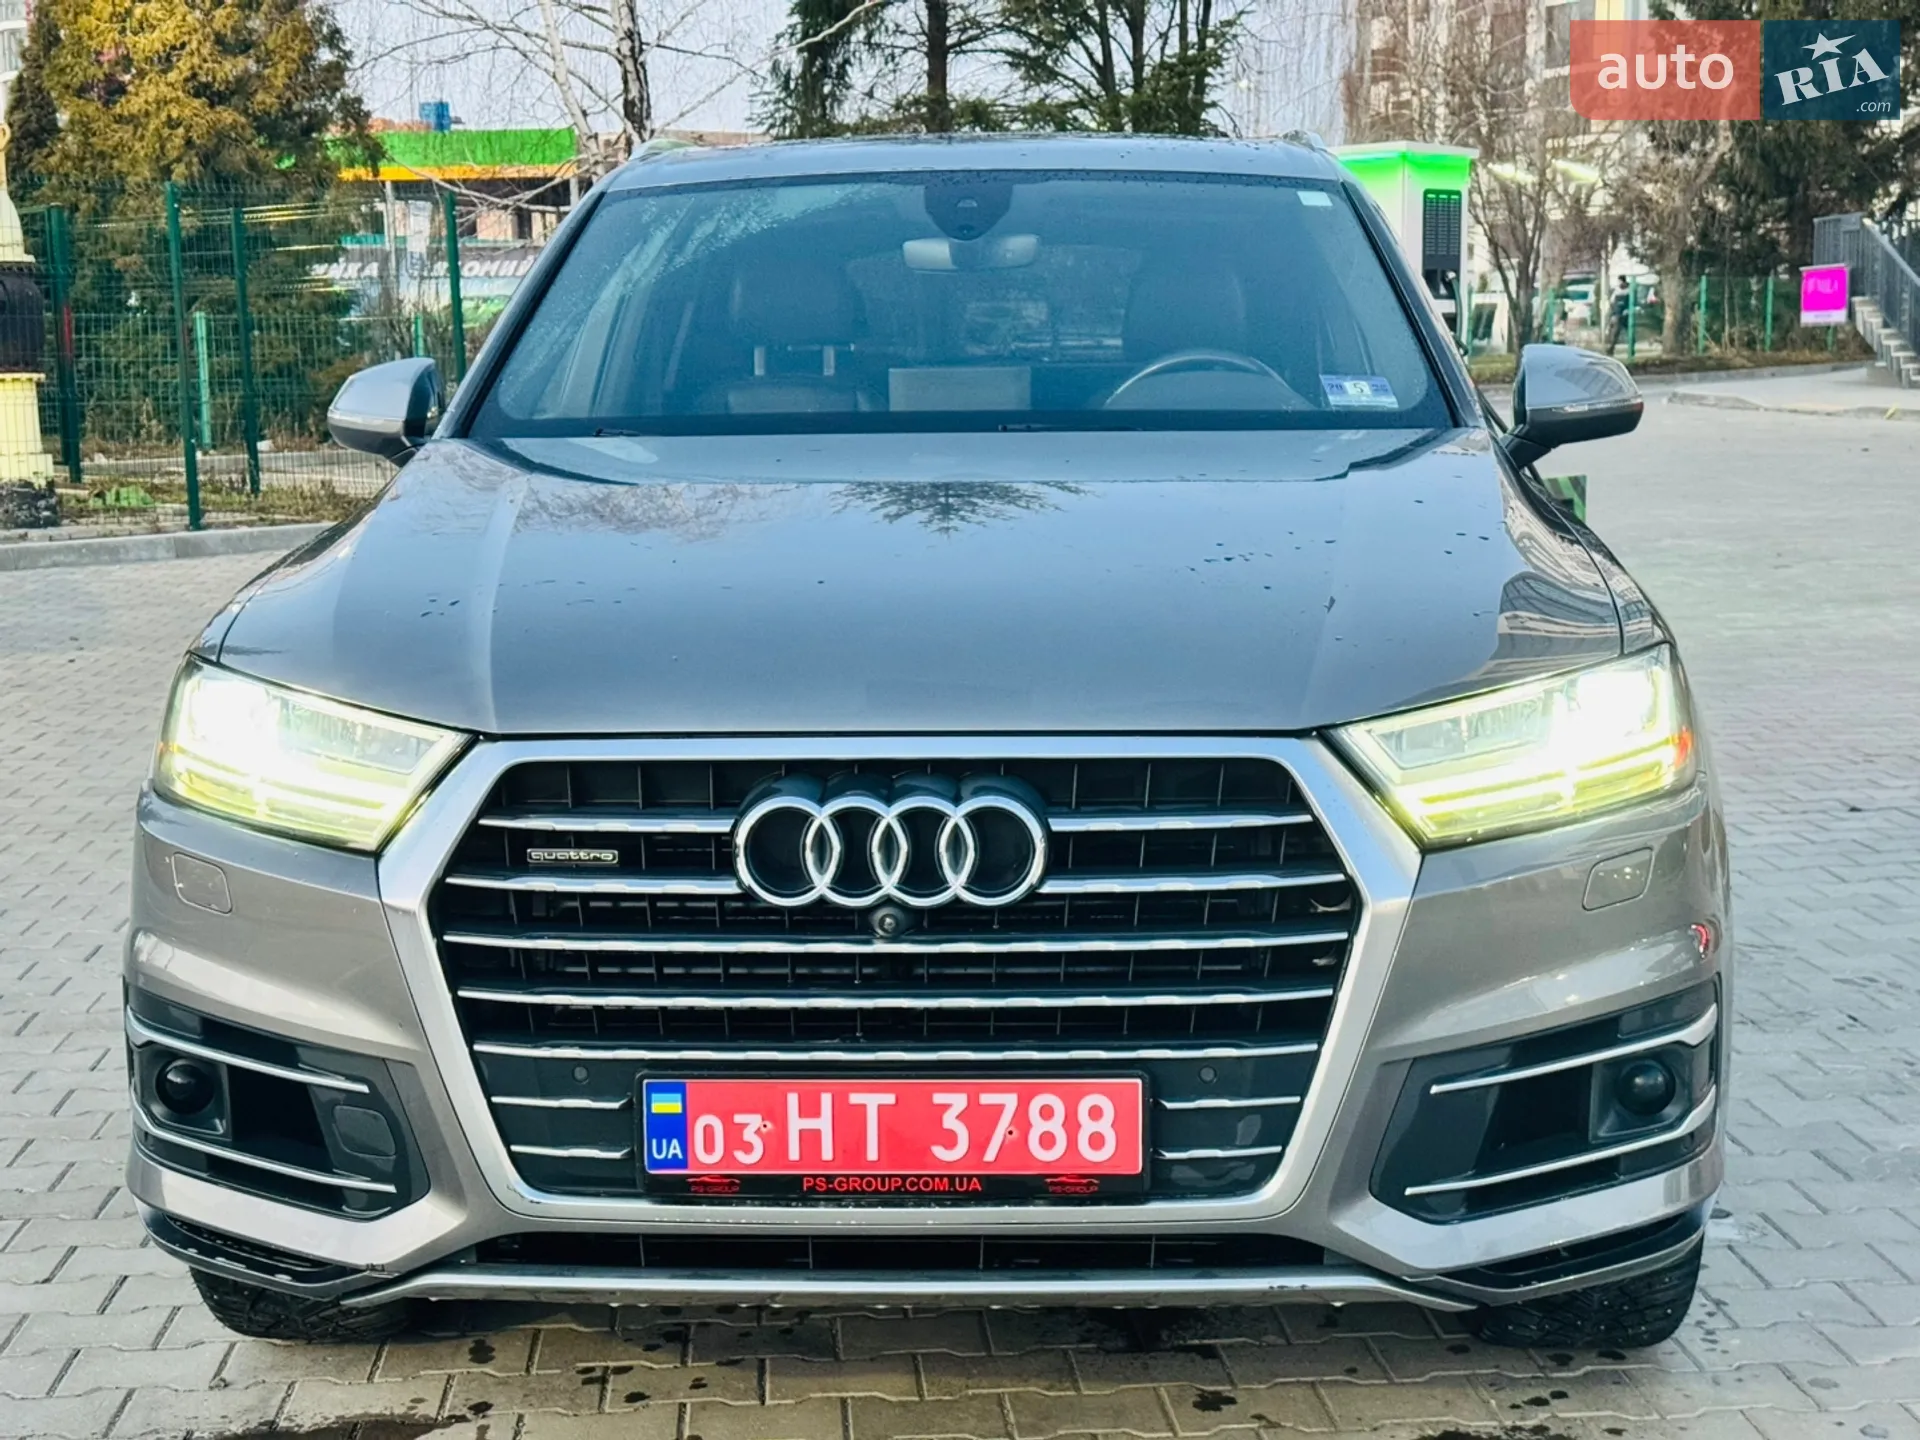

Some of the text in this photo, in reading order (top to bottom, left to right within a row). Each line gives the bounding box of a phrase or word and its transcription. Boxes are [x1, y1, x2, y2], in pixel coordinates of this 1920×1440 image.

[530, 851, 614, 861] quattro
[652, 1092, 1117, 1165] UA 03 HT 3788
[803, 1176, 982, 1193] PS-GROUP.COM.UA
